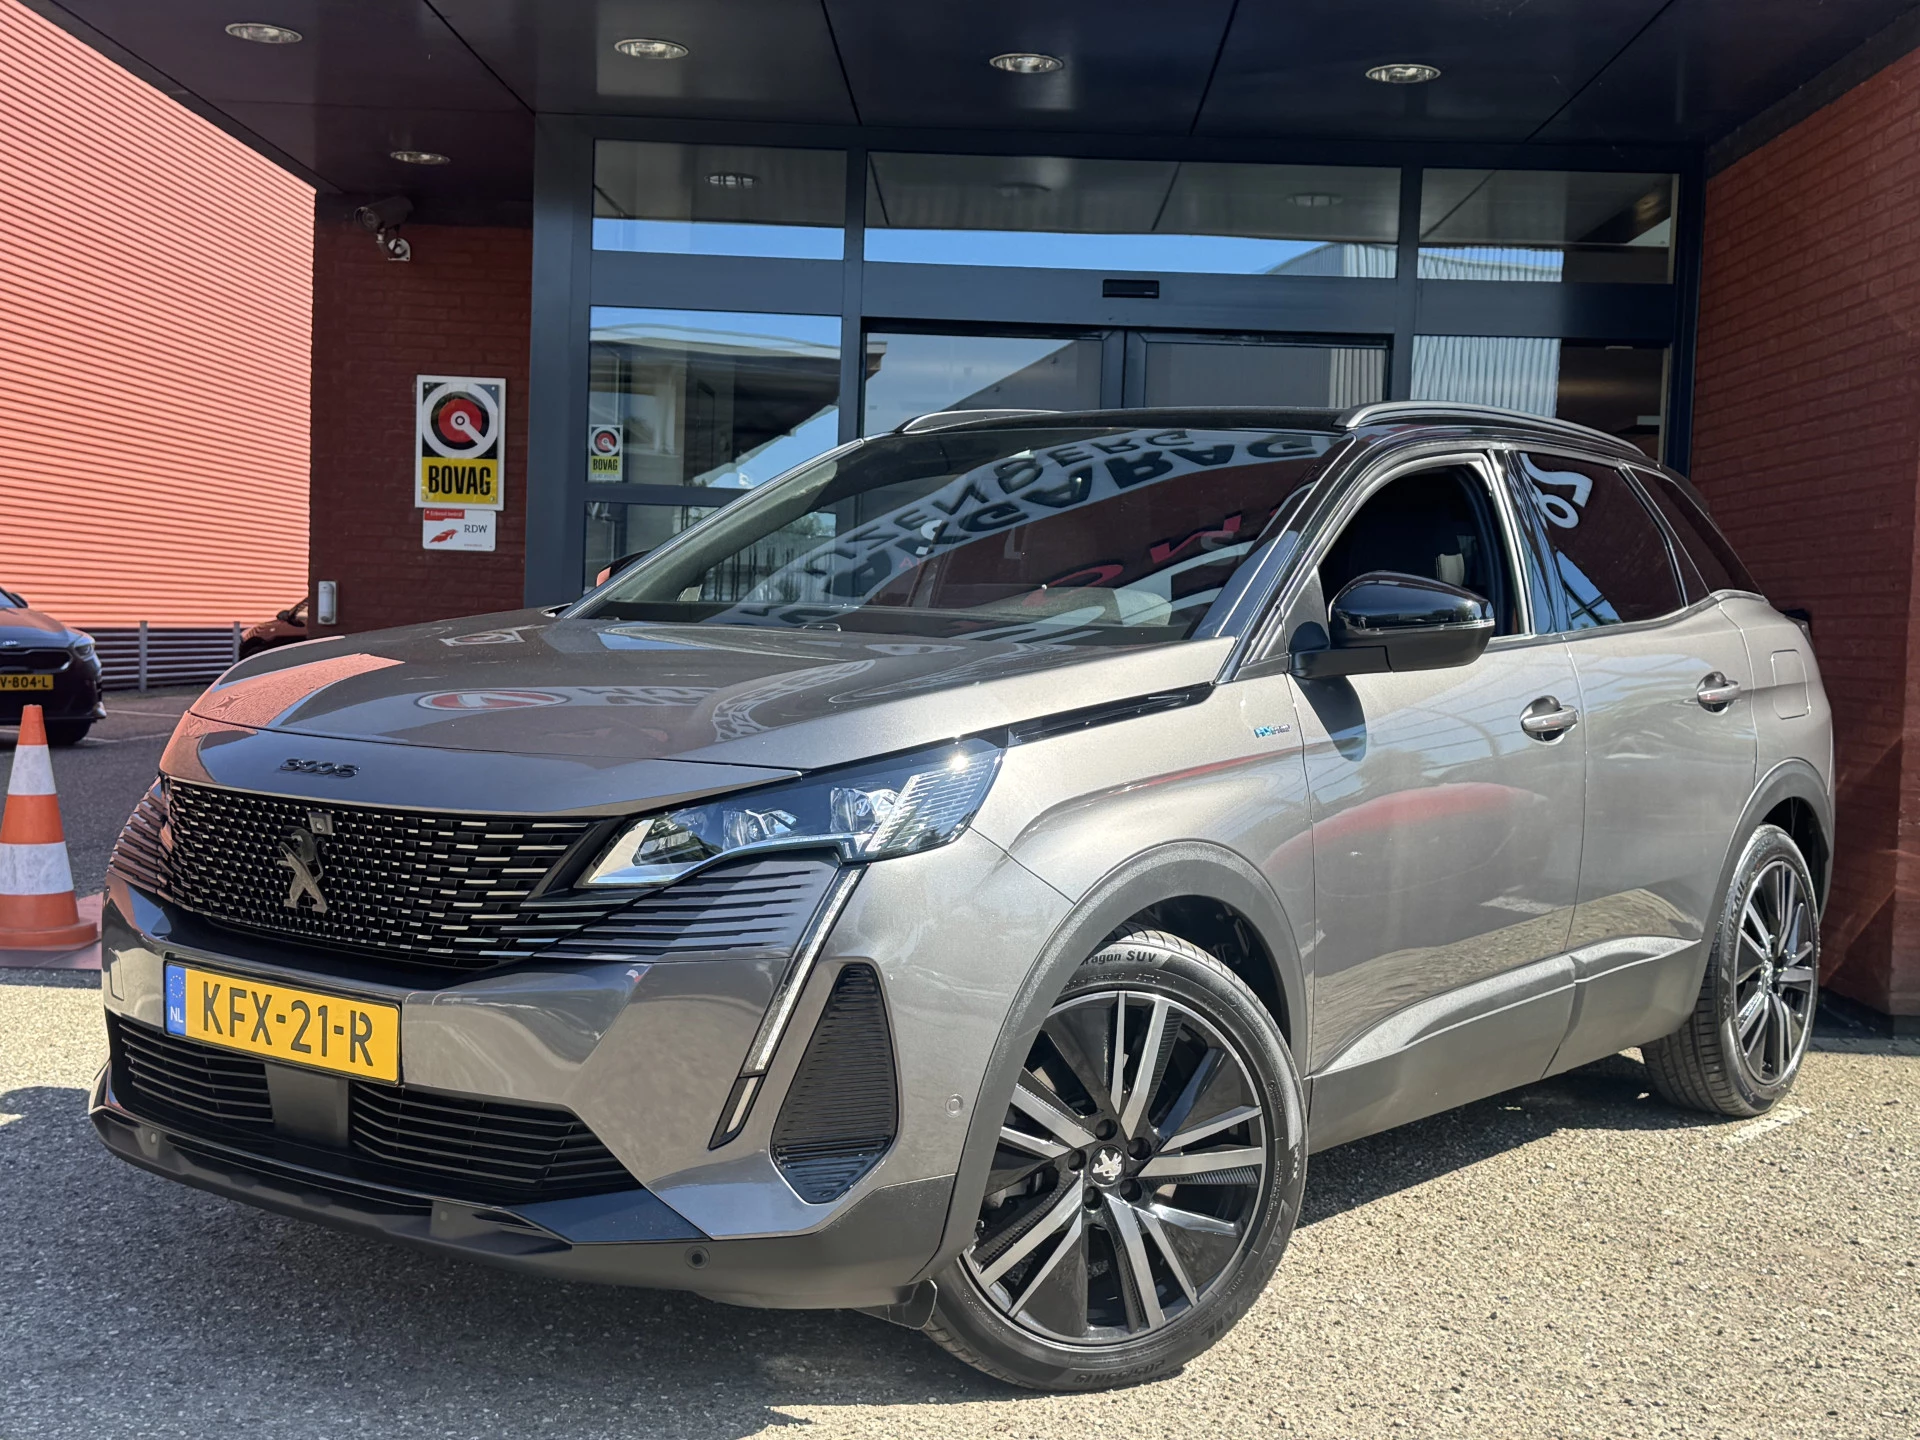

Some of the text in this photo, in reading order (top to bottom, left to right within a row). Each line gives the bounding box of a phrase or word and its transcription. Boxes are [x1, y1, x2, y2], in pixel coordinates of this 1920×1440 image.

[592, 458, 618, 471] BOVAG
[428, 465, 491, 496] BOVAG
[464, 524, 488, 533] RDW
[0, 676, 49, 688] V-804-L
[1080, 950, 1158, 966] ragon SUV
[169, 1005, 184, 1024] NL
[203, 981, 374, 1067] KFX-21-R
